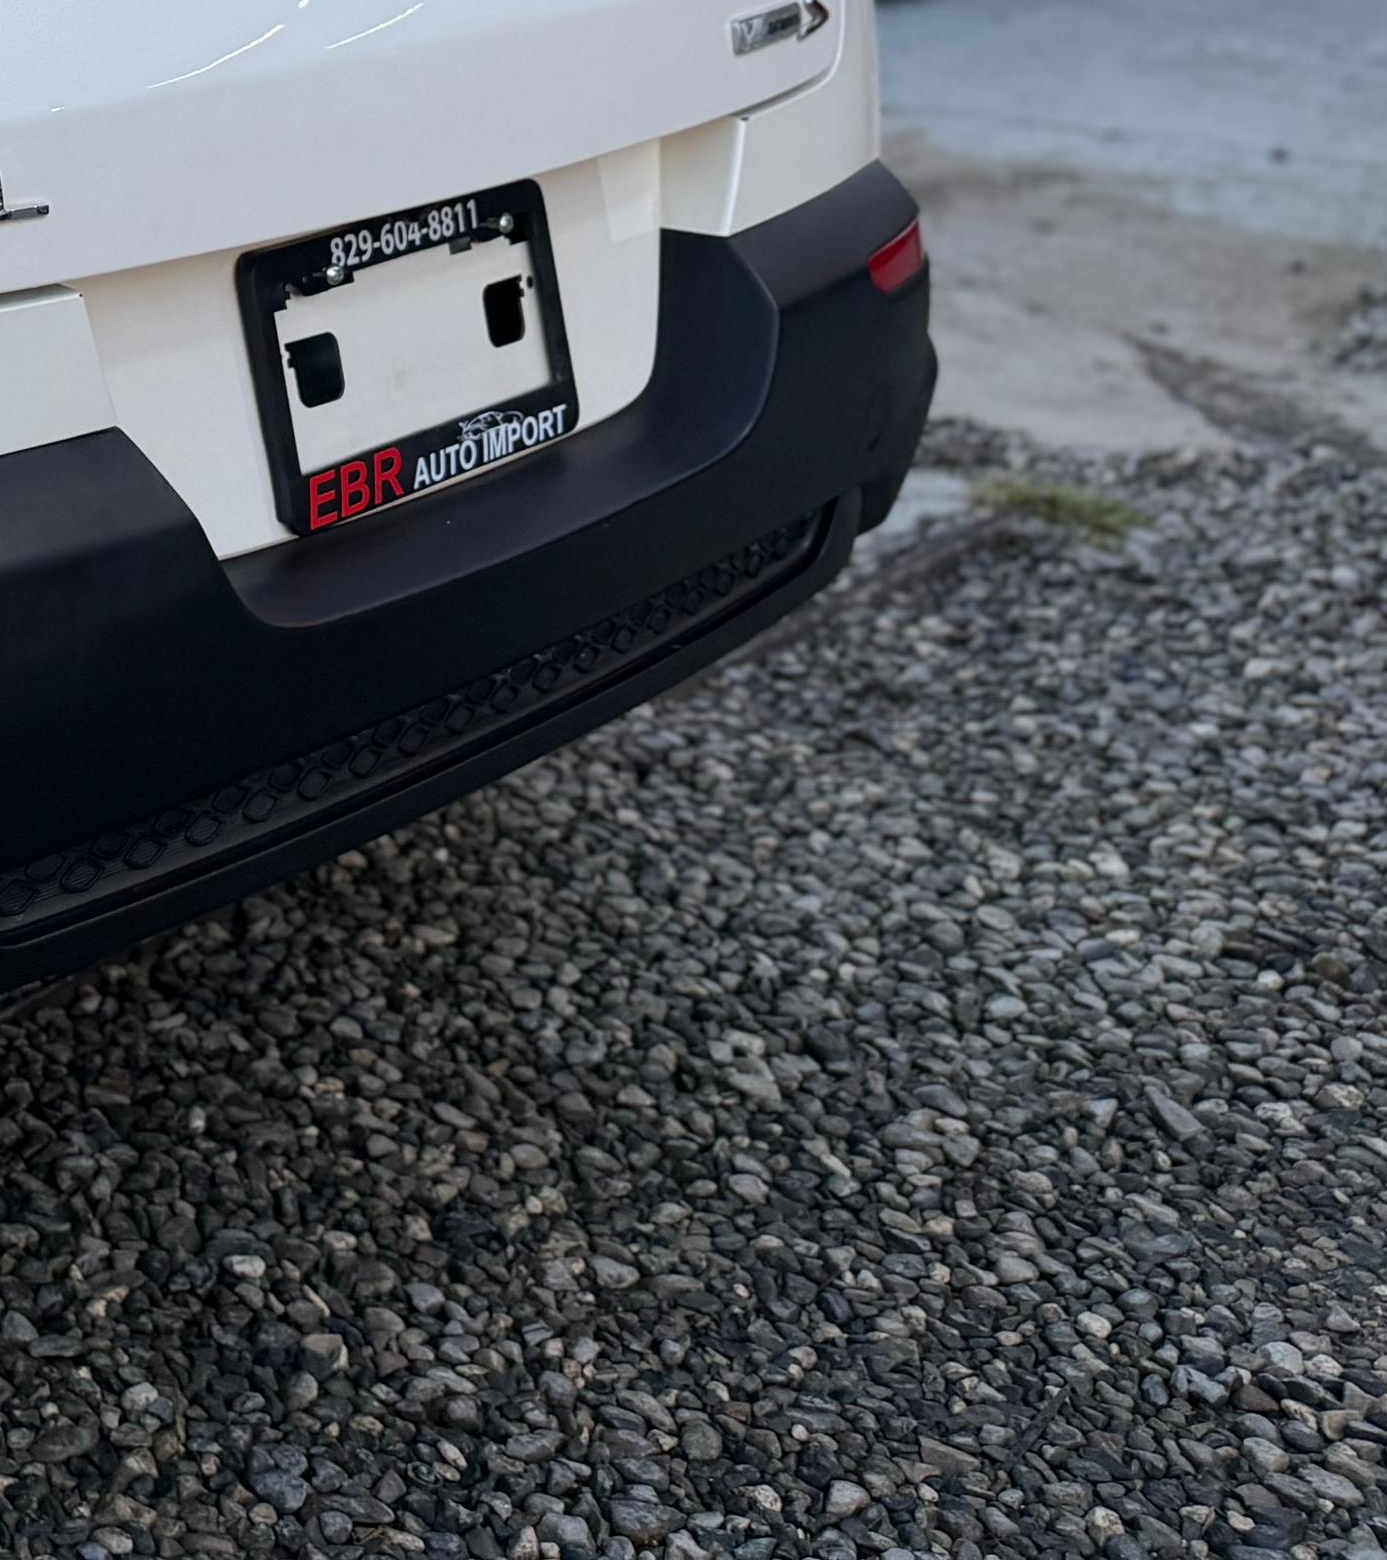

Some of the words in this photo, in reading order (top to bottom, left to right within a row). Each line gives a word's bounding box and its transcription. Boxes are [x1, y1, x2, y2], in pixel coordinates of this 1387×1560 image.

[330, 198, 478, 268] 829-604-8811
[309, 446, 405, 530] EBR
[414, 439, 477, 490] AUTO
[482, 404, 567, 463] IMPORT
